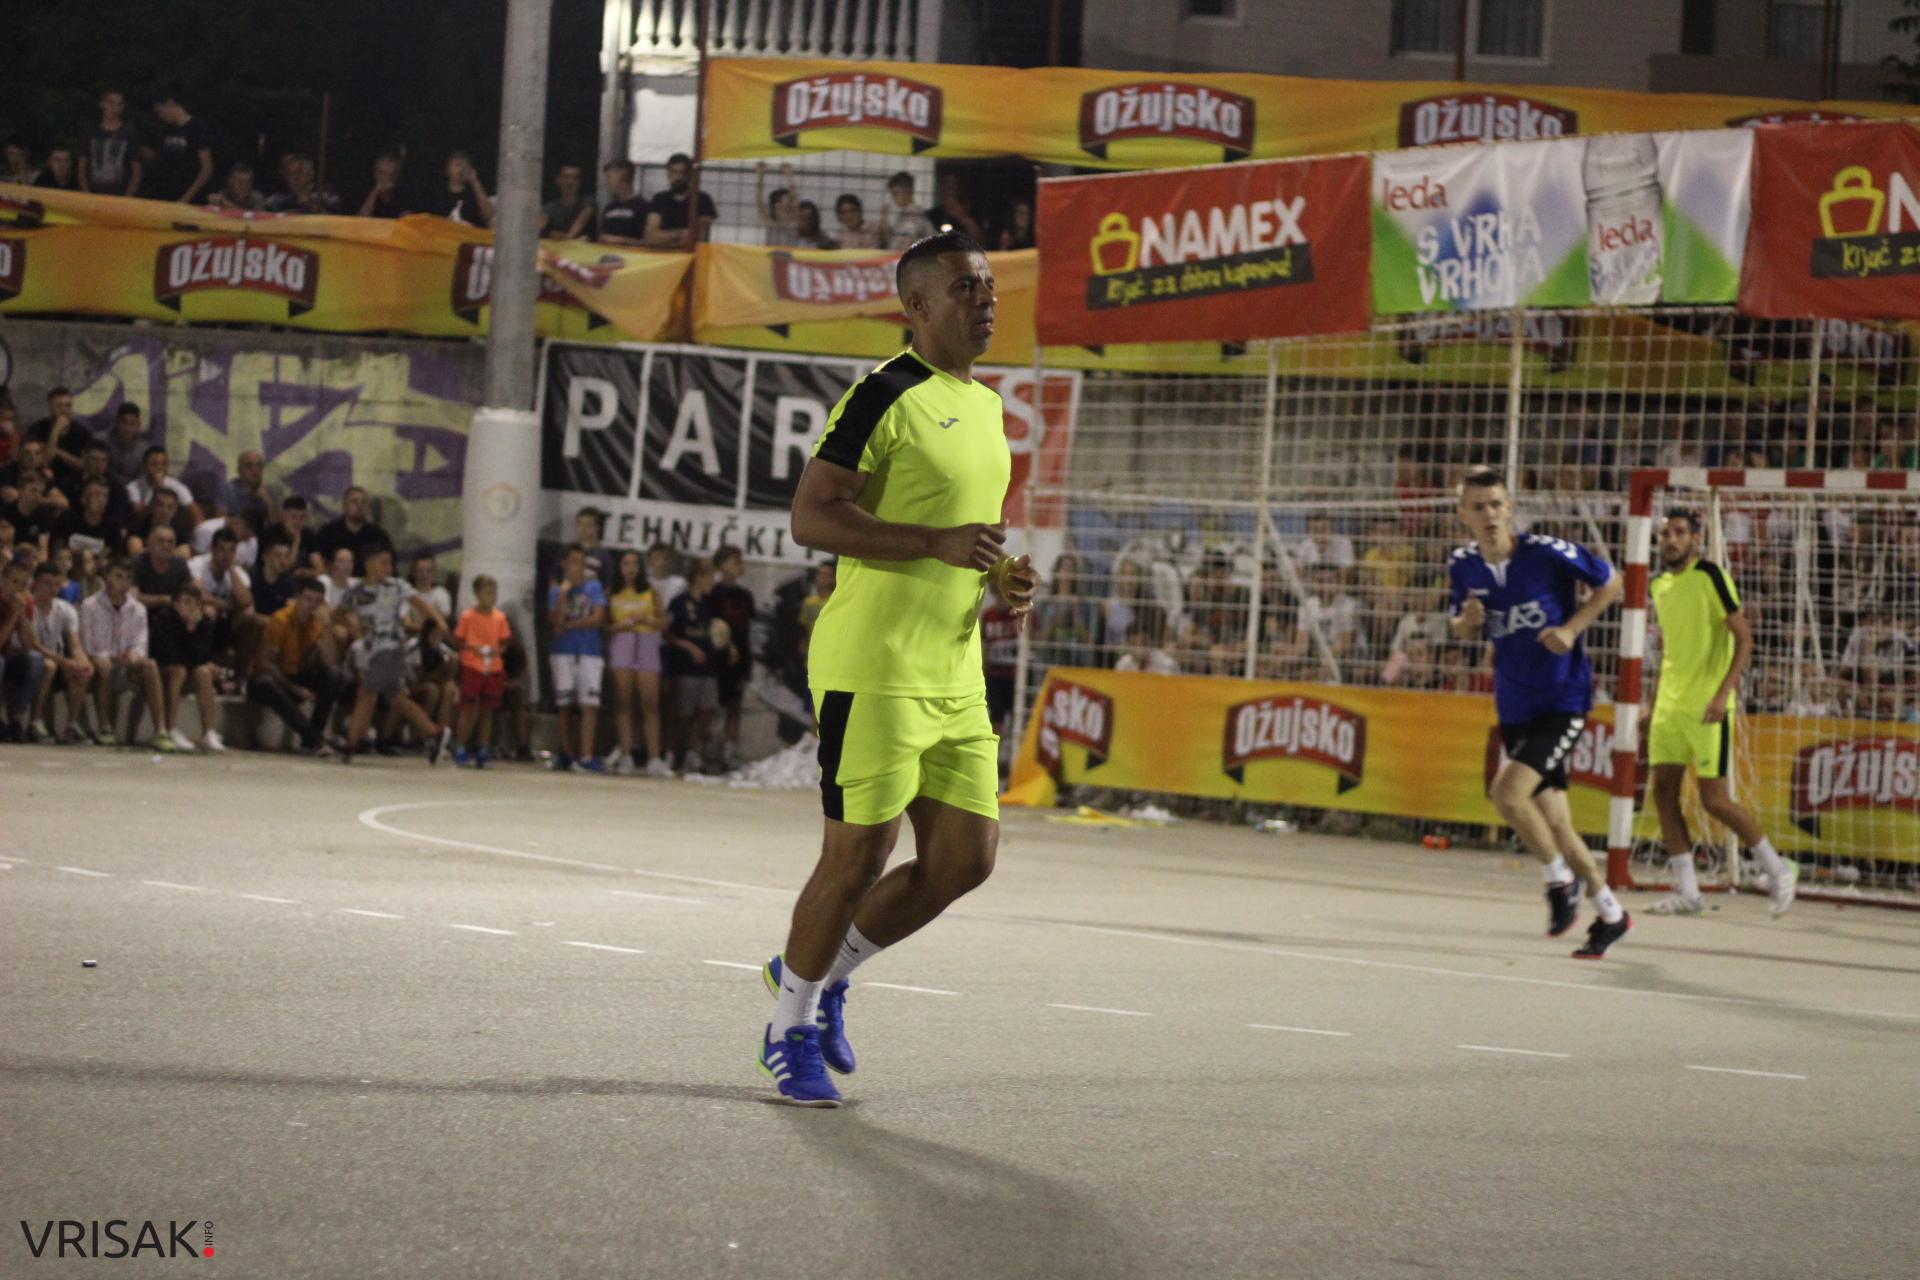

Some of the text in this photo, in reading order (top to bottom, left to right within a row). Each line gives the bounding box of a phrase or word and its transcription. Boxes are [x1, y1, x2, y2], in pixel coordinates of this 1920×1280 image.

[786, 74, 930, 128] Ožujsko
[1093, 84, 1242, 139] Ožujsko
[1383, 176, 1448, 212] leda
[1140, 196, 1306, 268] NAMEX
[1416, 225, 1440, 264] S
[1598, 214, 1655, 252] leda
[169, 240, 306, 291] Ožujsko
[598, 511, 788, 558] TEHNIČKI
[1235, 699, 1356, 763] Ožujsko
